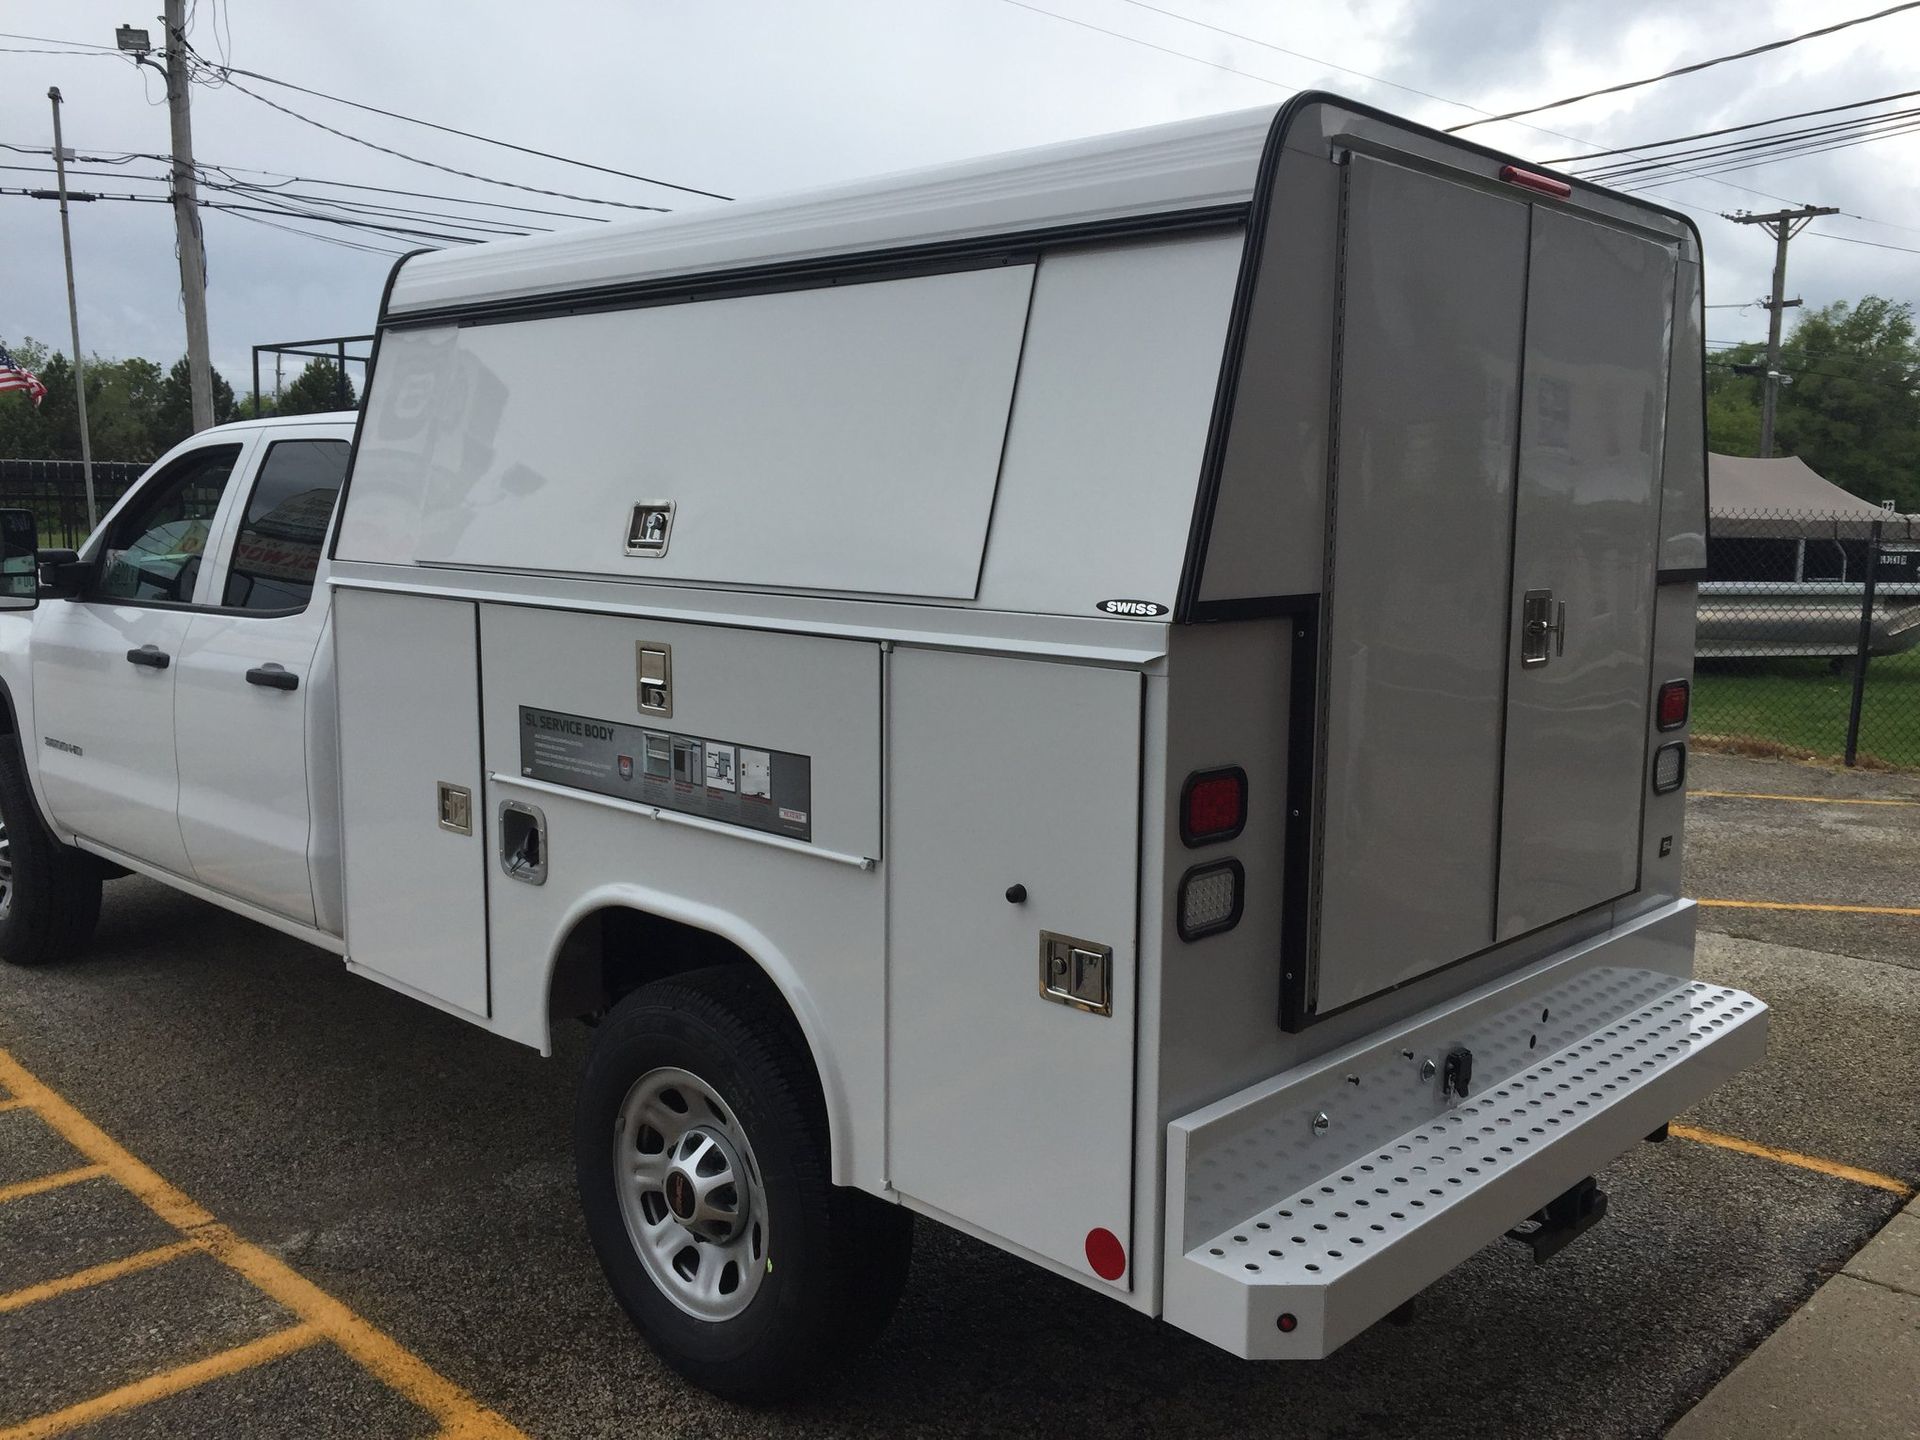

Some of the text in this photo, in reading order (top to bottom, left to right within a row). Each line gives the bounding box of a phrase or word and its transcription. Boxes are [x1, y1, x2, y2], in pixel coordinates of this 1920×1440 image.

[1106, 601, 1157, 615] SWISS
[525, 713, 537, 727] SL
[539, 715, 582, 737] SERVICE
[584, 723, 615, 742] BODY
